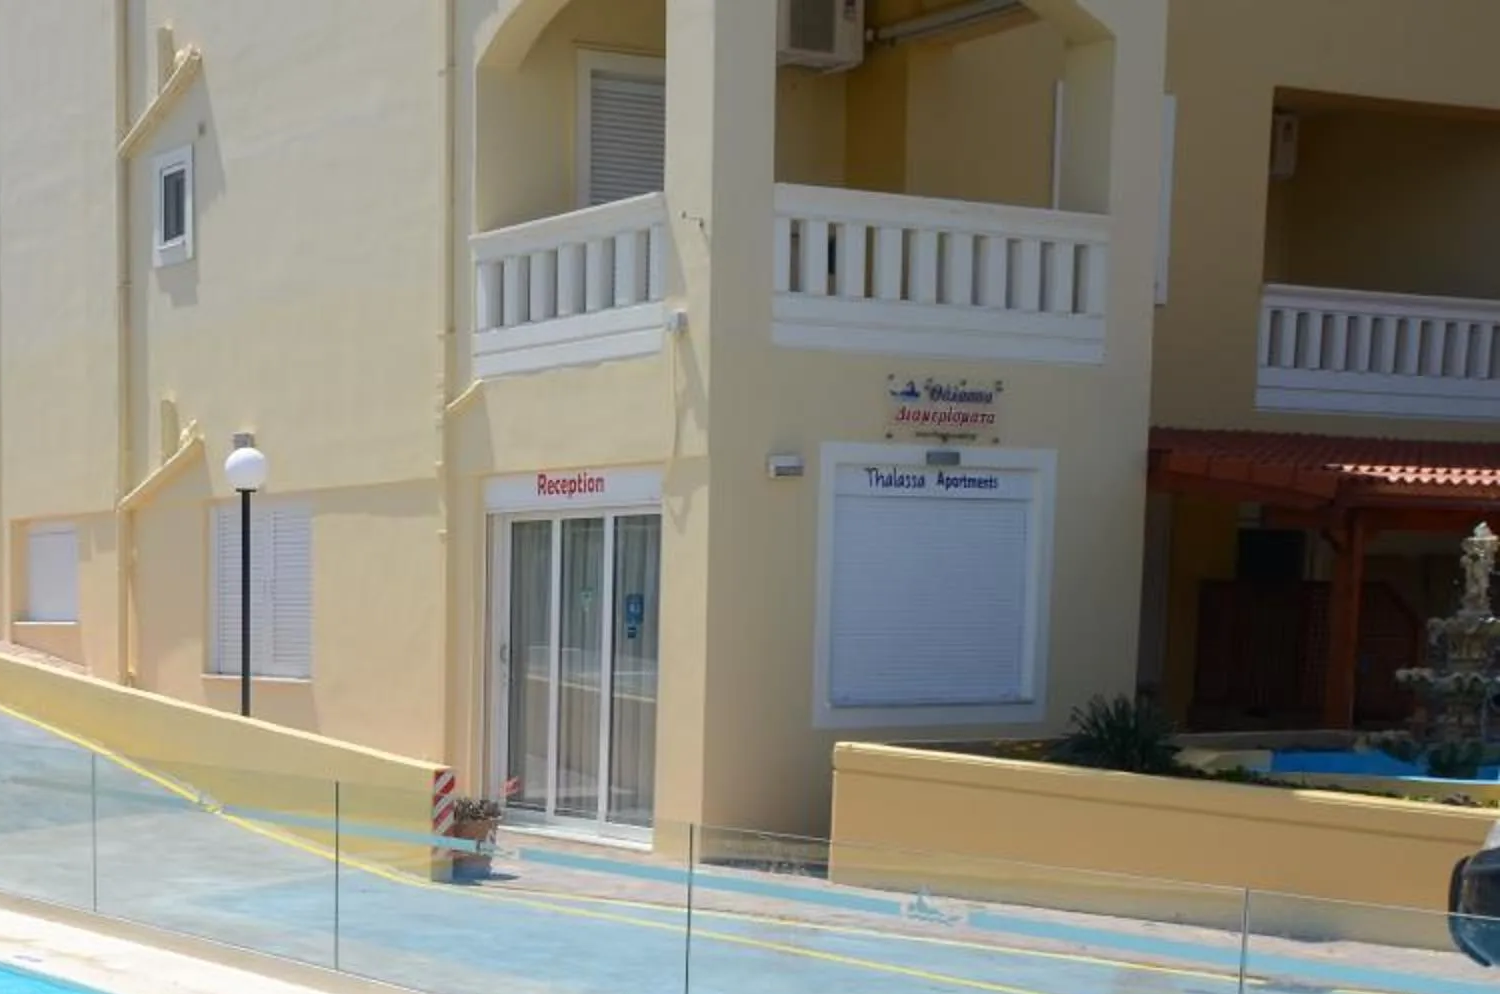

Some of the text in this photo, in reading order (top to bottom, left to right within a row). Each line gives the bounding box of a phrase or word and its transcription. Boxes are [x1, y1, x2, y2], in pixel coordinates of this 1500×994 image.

[537, 471, 605, 499] Reception
[864, 466, 999, 491] Thalassa Apartments
